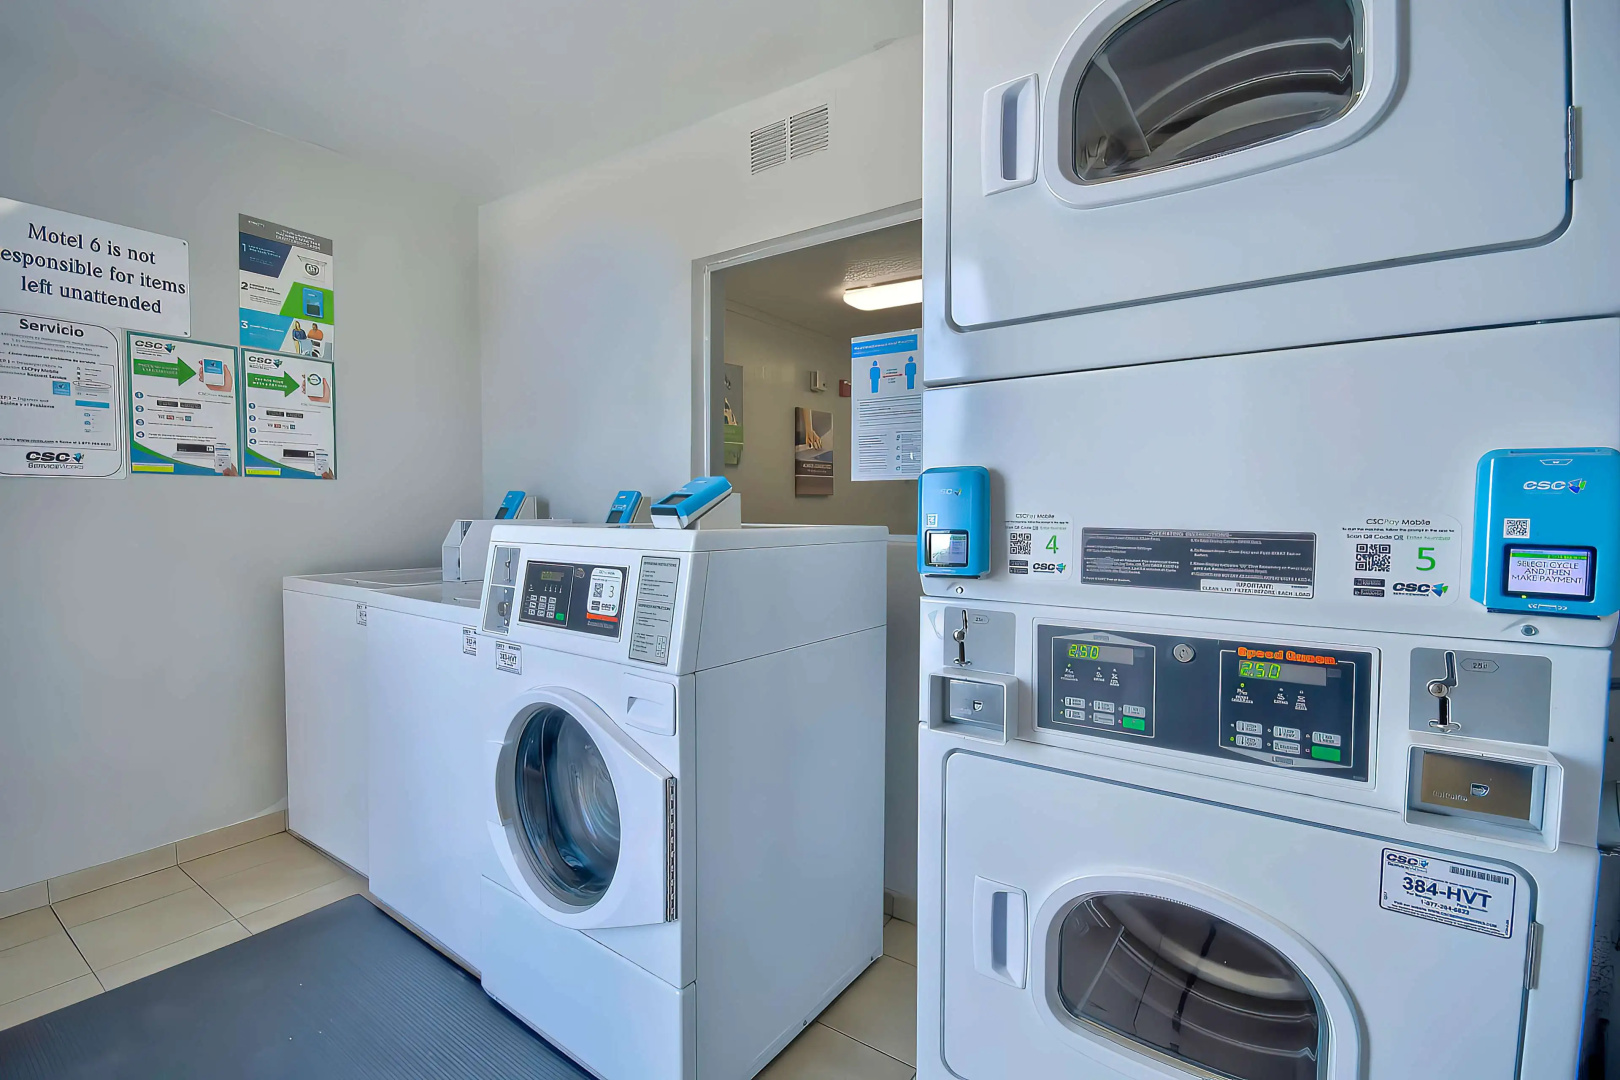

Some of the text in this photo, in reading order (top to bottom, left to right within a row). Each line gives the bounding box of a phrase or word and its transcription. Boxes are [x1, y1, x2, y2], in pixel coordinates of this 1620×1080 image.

[28, 222, 156, 264] Motel 6 is not
[0, 248, 186, 294] esponsible for items
[241, 281, 249, 290] 2
[21, 275, 161, 313] left unattended
[19, 318, 84, 337] Servicio
[240, 320, 249, 329] 3
[134, 340, 163, 350] CSC
[248, 356, 273, 365] CSC
[26, 451, 70, 462] CSC
[1522, 480, 1566, 491] CSC
[1365, 518, 1399, 526] CSCPay
[1046, 535, 1059, 554] 4
[1415, 547, 1436, 571] 5
[1033, 562, 1055, 571] CSC
[1516, 560, 1579, 570] SELECT CYCLE
[1524, 567, 1545, 575] AND
[1539, 575, 1583, 584] PAYMENT
[608, 585, 615, 598] 3
[1392, 582, 1431, 593] CSC
[1237, 647, 1338, 665] Speed Queen
[1386, 853, 1418, 866] CSC
[1402, 876, 1492, 908] 384-HVT
